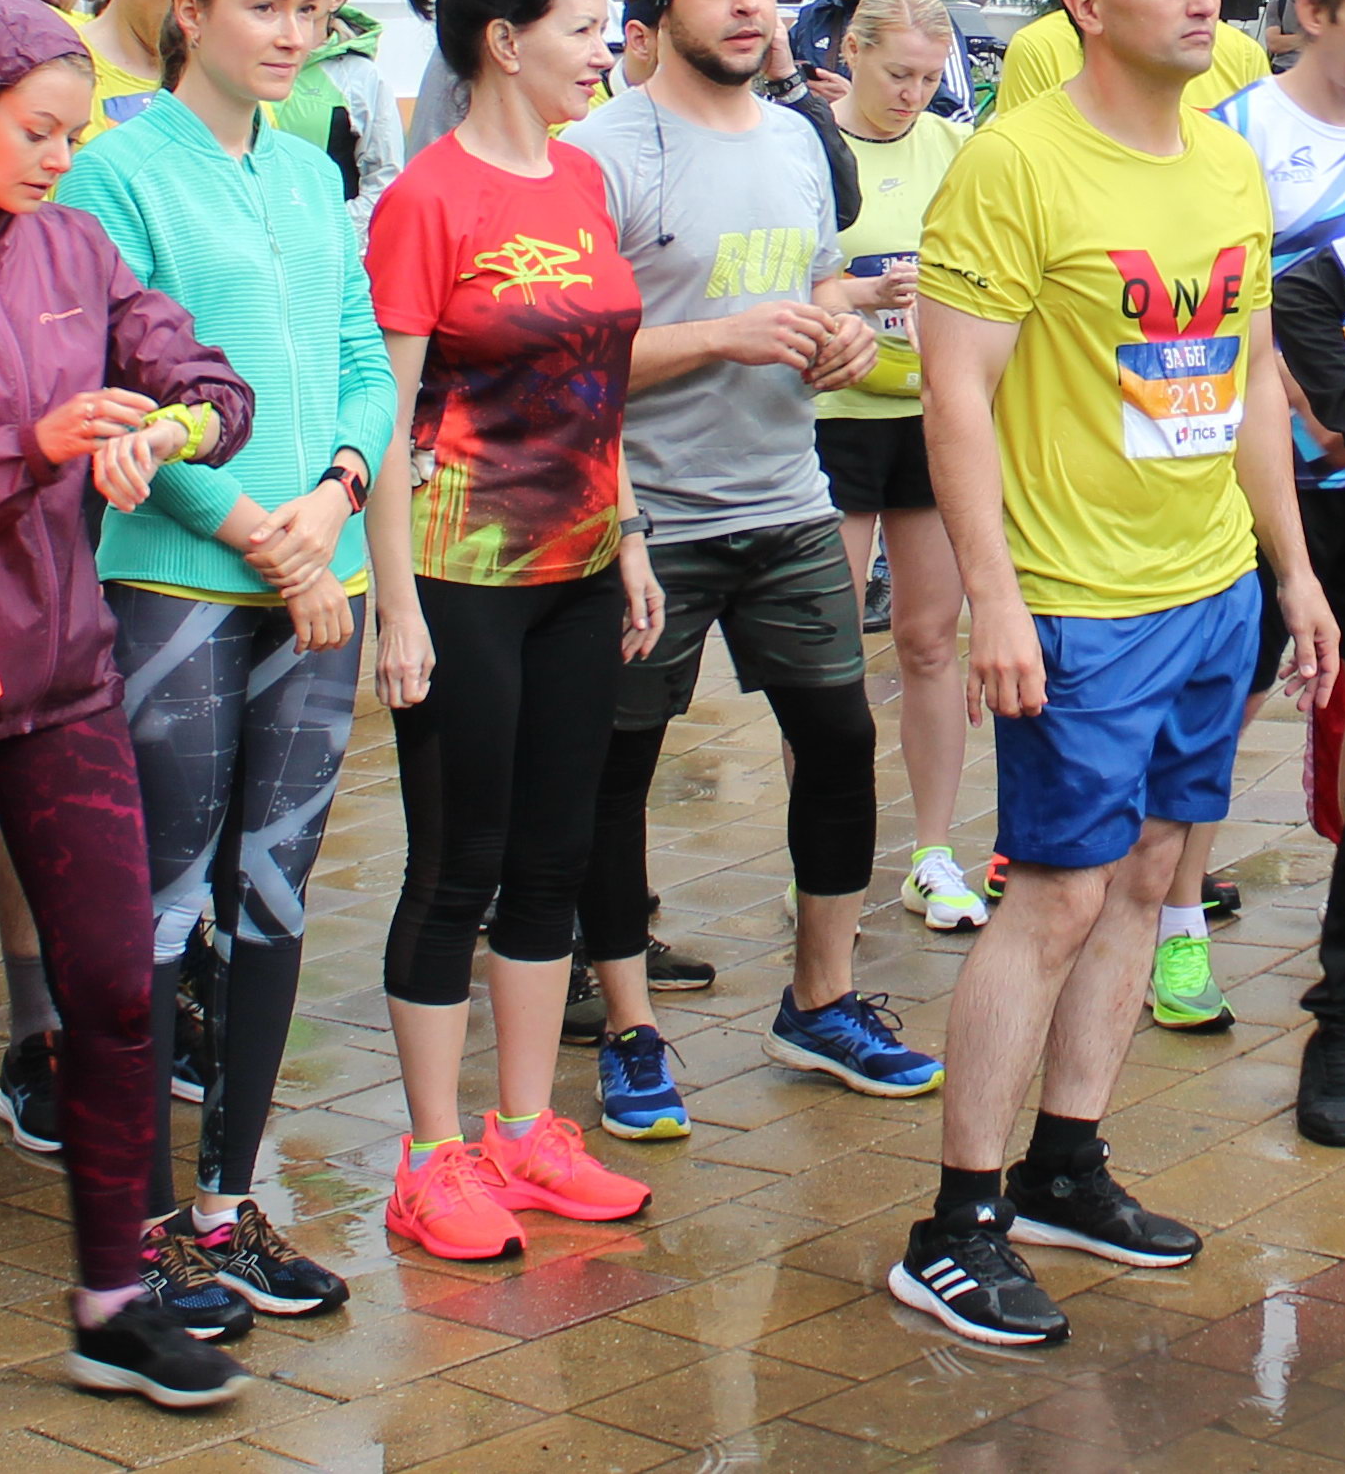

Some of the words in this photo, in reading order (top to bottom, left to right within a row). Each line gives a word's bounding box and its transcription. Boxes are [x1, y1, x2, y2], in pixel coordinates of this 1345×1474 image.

[1122, 276, 1241, 319] ONE
[1167, 382, 1218, 414] 213
[1192, 427, 1216, 441] ПСБ
